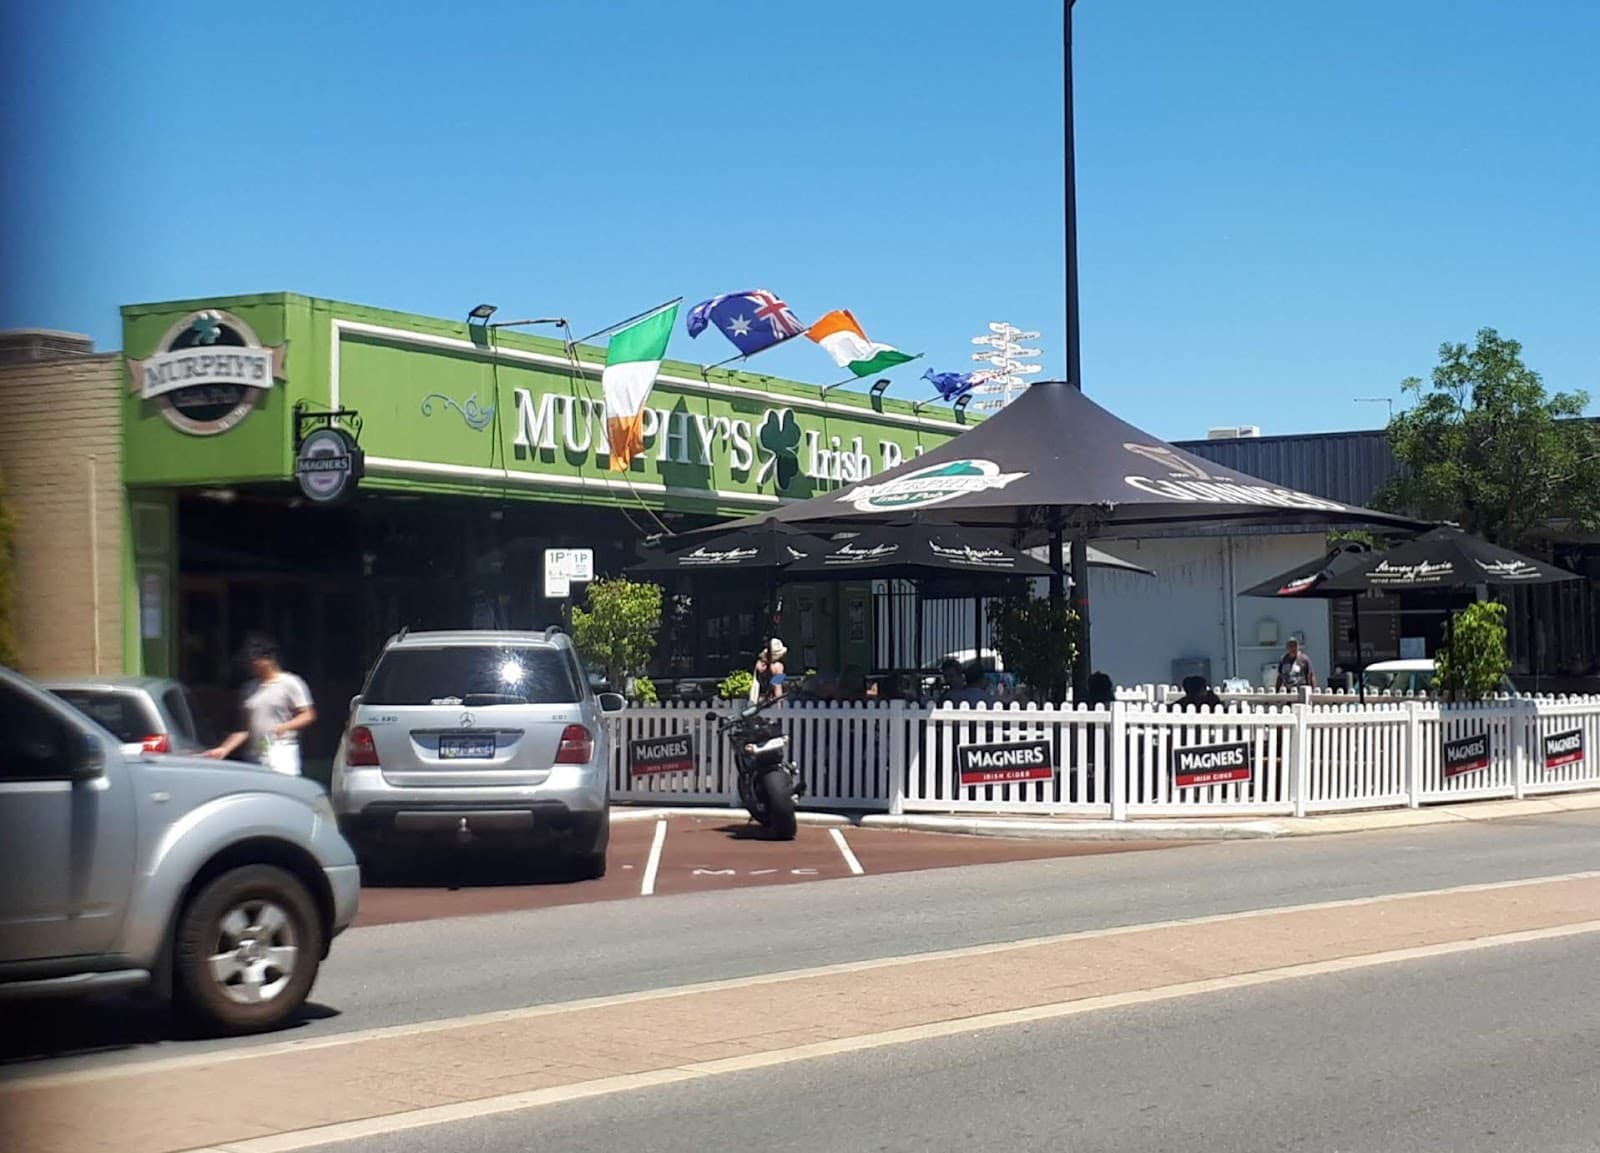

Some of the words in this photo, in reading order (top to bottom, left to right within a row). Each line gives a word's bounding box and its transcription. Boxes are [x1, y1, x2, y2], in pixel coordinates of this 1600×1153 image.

[806, 430, 872, 482] Irish
[550, 552, 565, 563] 1P
[575, 553, 588, 563] 1P
[636, 740, 688, 760] MAGNERS
[967, 746, 1044, 768] MAGNERS
[1180, 748, 1244, 770] MAGNERS
[1006, 770, 1030, 779] CIDER
